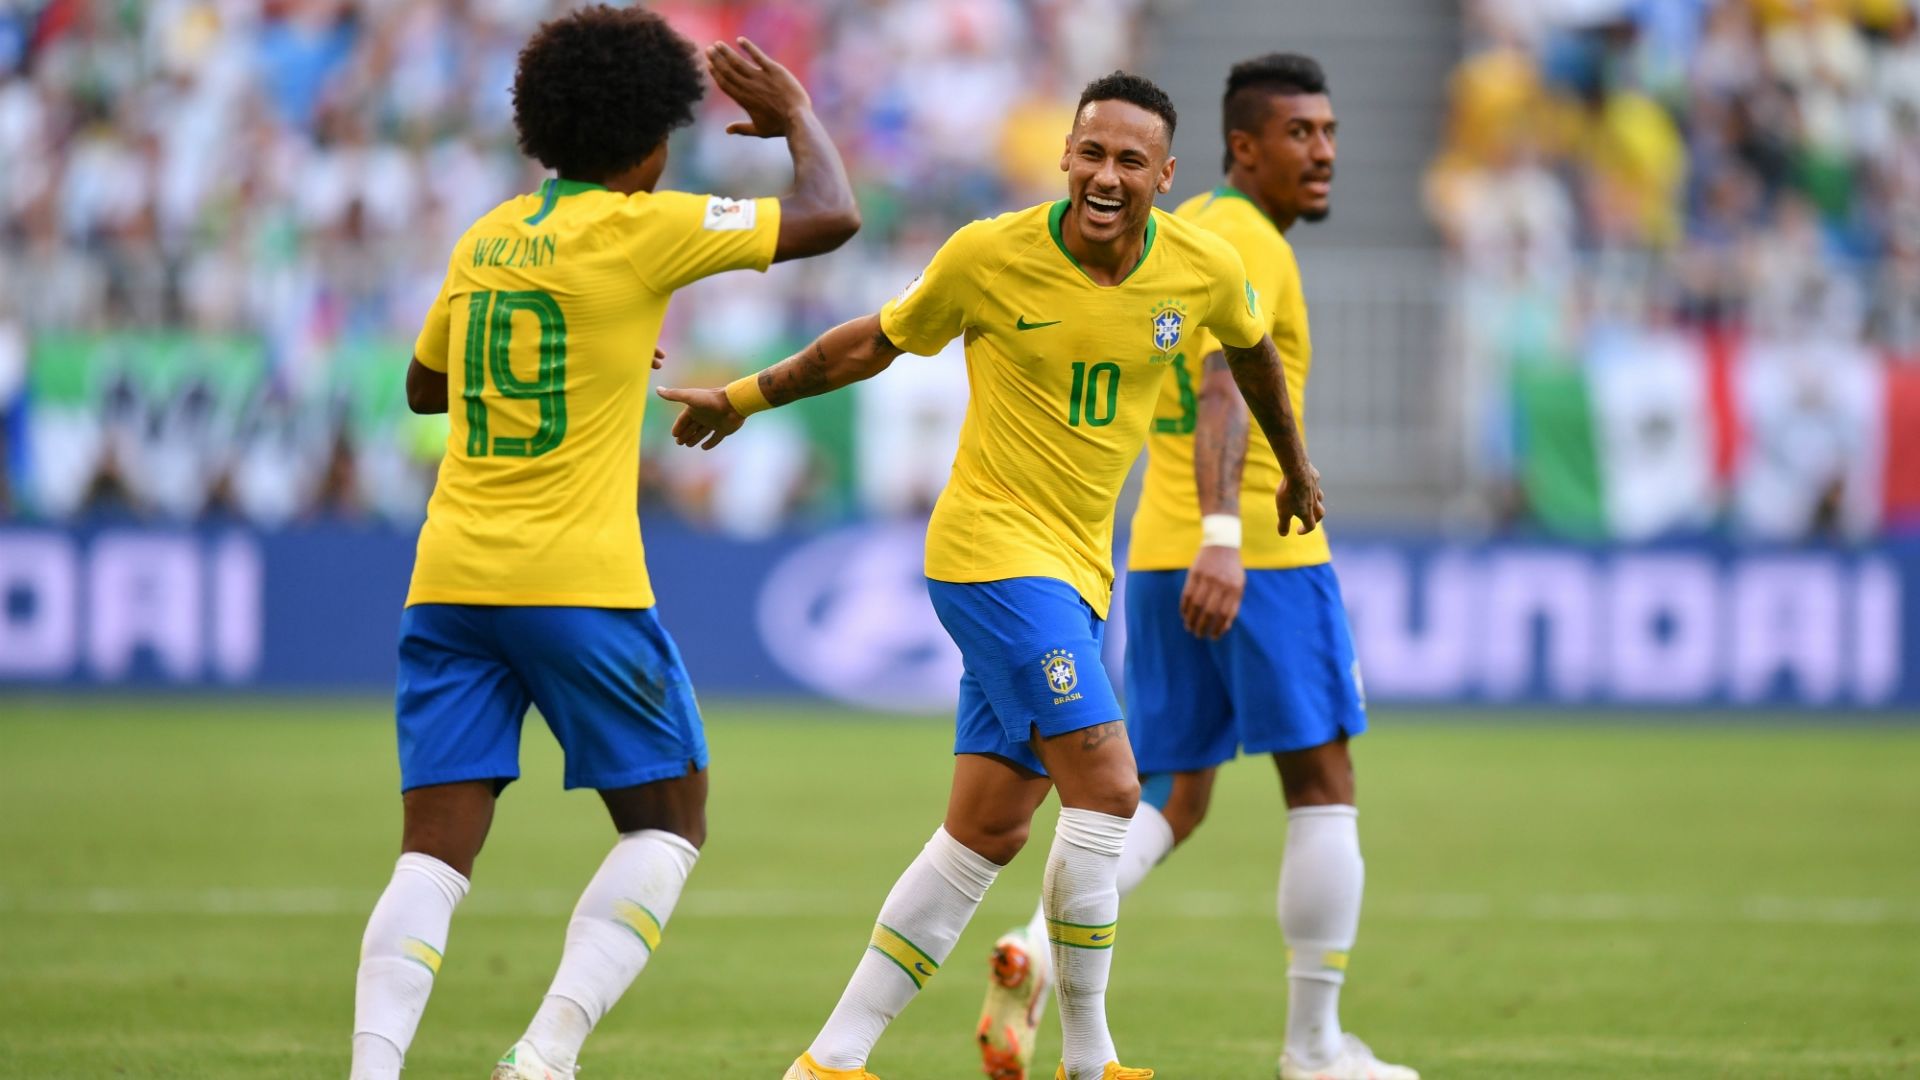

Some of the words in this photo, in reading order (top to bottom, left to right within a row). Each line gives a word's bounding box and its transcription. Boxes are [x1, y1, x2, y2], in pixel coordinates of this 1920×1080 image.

[473, 234, 557, 268] WILLIAN
[464, 290, 567, 457] 19
[1068, 361, 1121, 427] 10
[1325, 545, 1898, 702] UNDAI
[1053, 692, 1083, 705] BRASIL
